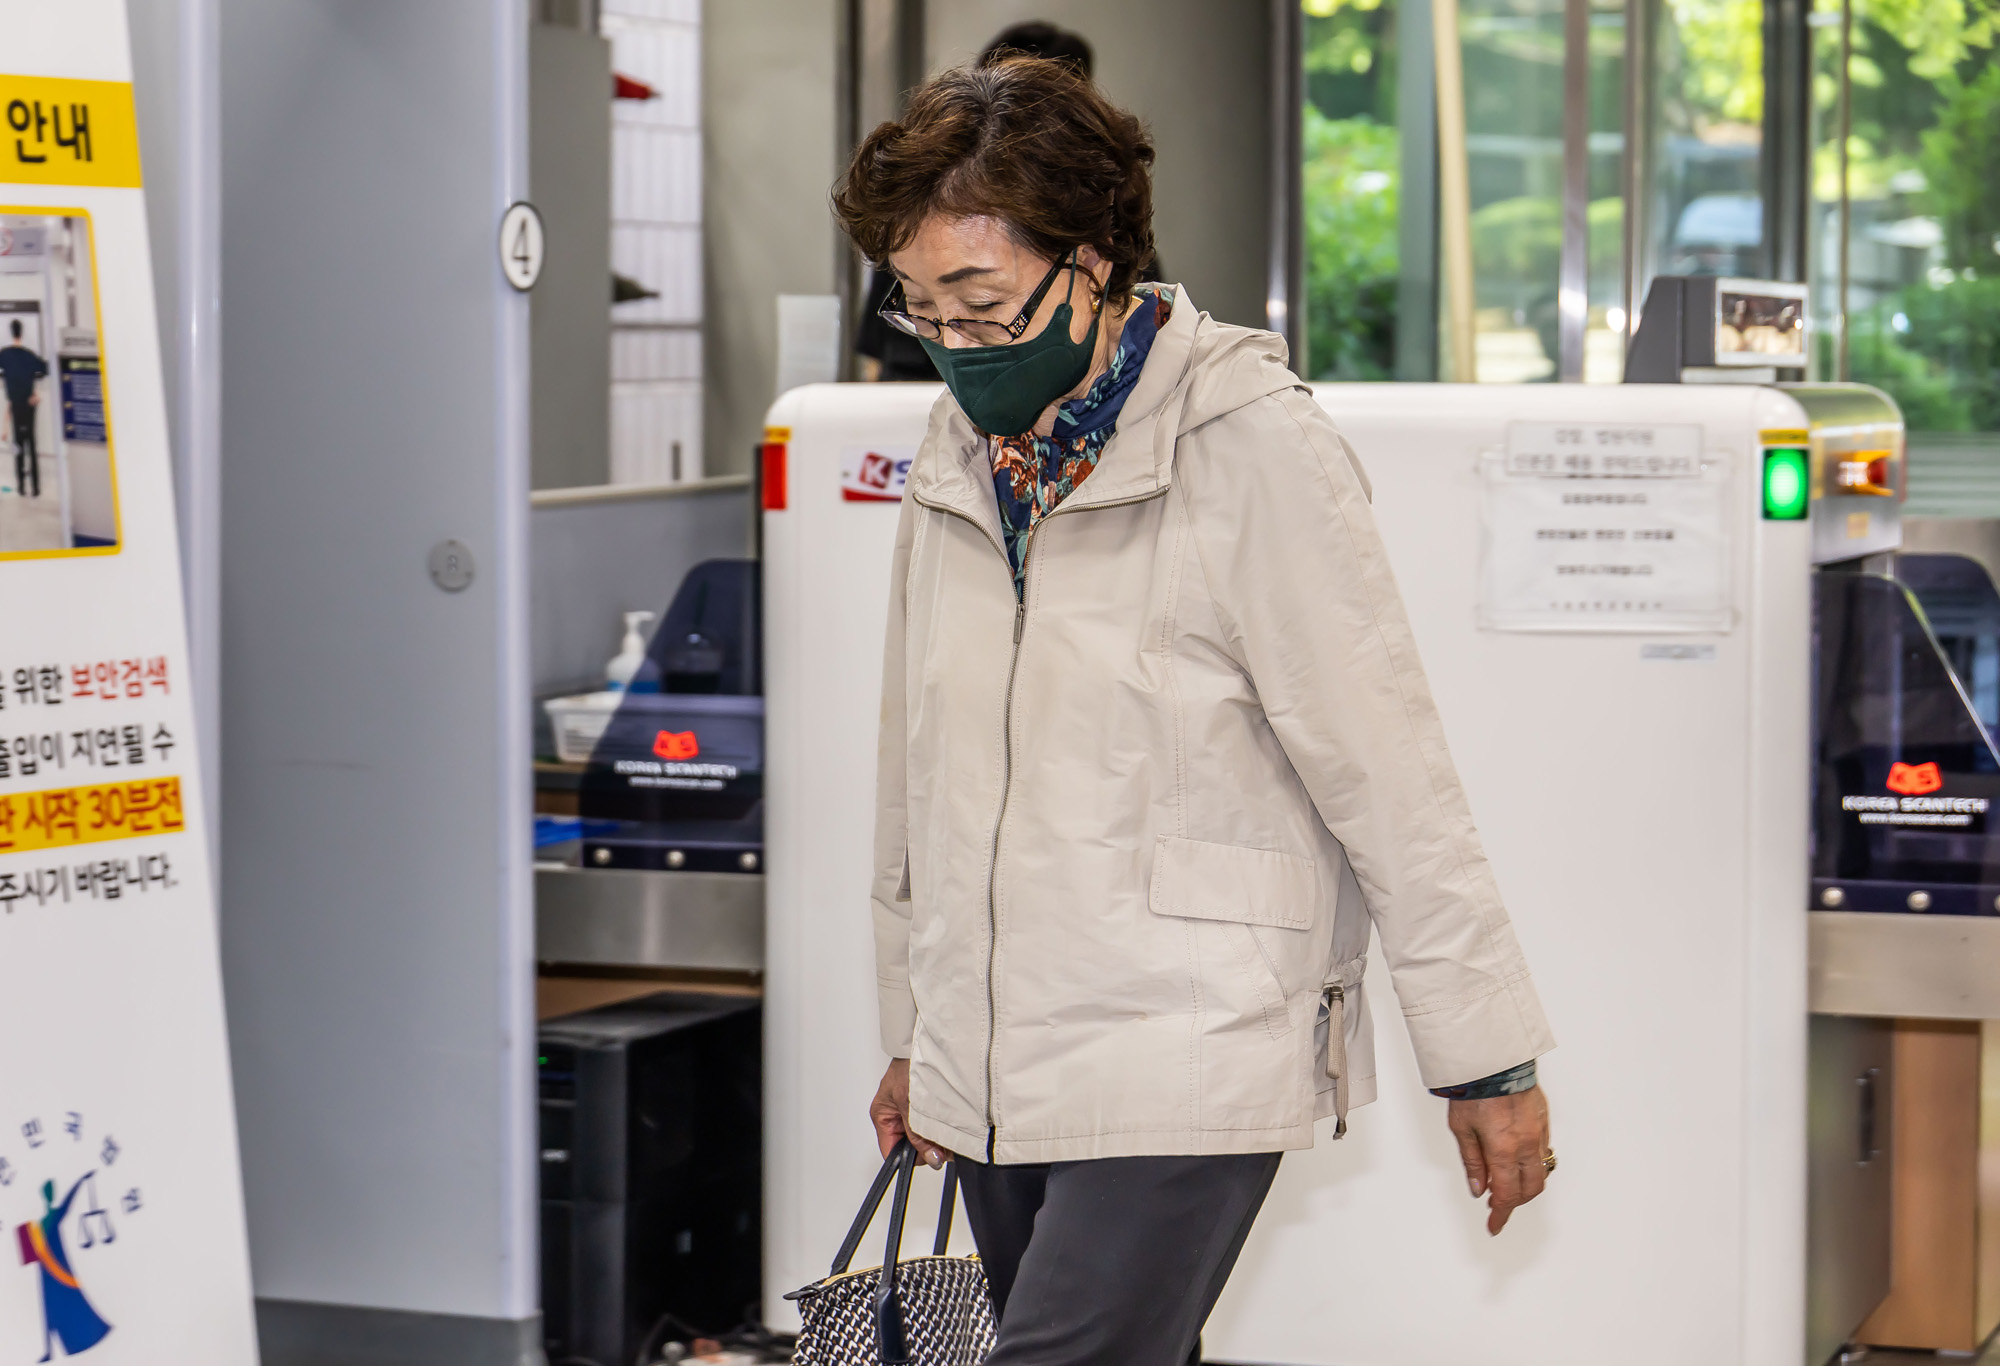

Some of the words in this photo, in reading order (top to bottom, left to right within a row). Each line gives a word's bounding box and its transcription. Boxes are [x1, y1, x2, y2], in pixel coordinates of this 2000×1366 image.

[7, 98, 92, 163] 안내
[512, 218, 530, 275] 4
[13, 664, 63, 705] 위한
[71, 655, 170, 700] 보안검색
[71, 724, 145, 766] 지연될
[152, 721, 175, 762] 수
[614, 760, 662, 774] KOREA
[24, 789, 80, 840] 시작
[89, 777, 183, 832] 30분전
[1842, 795, 1898, 811] KOREA
[1900, 797, 1988, 813] SCANTECH
[74, 853, 179, 899] 바랍니다.
